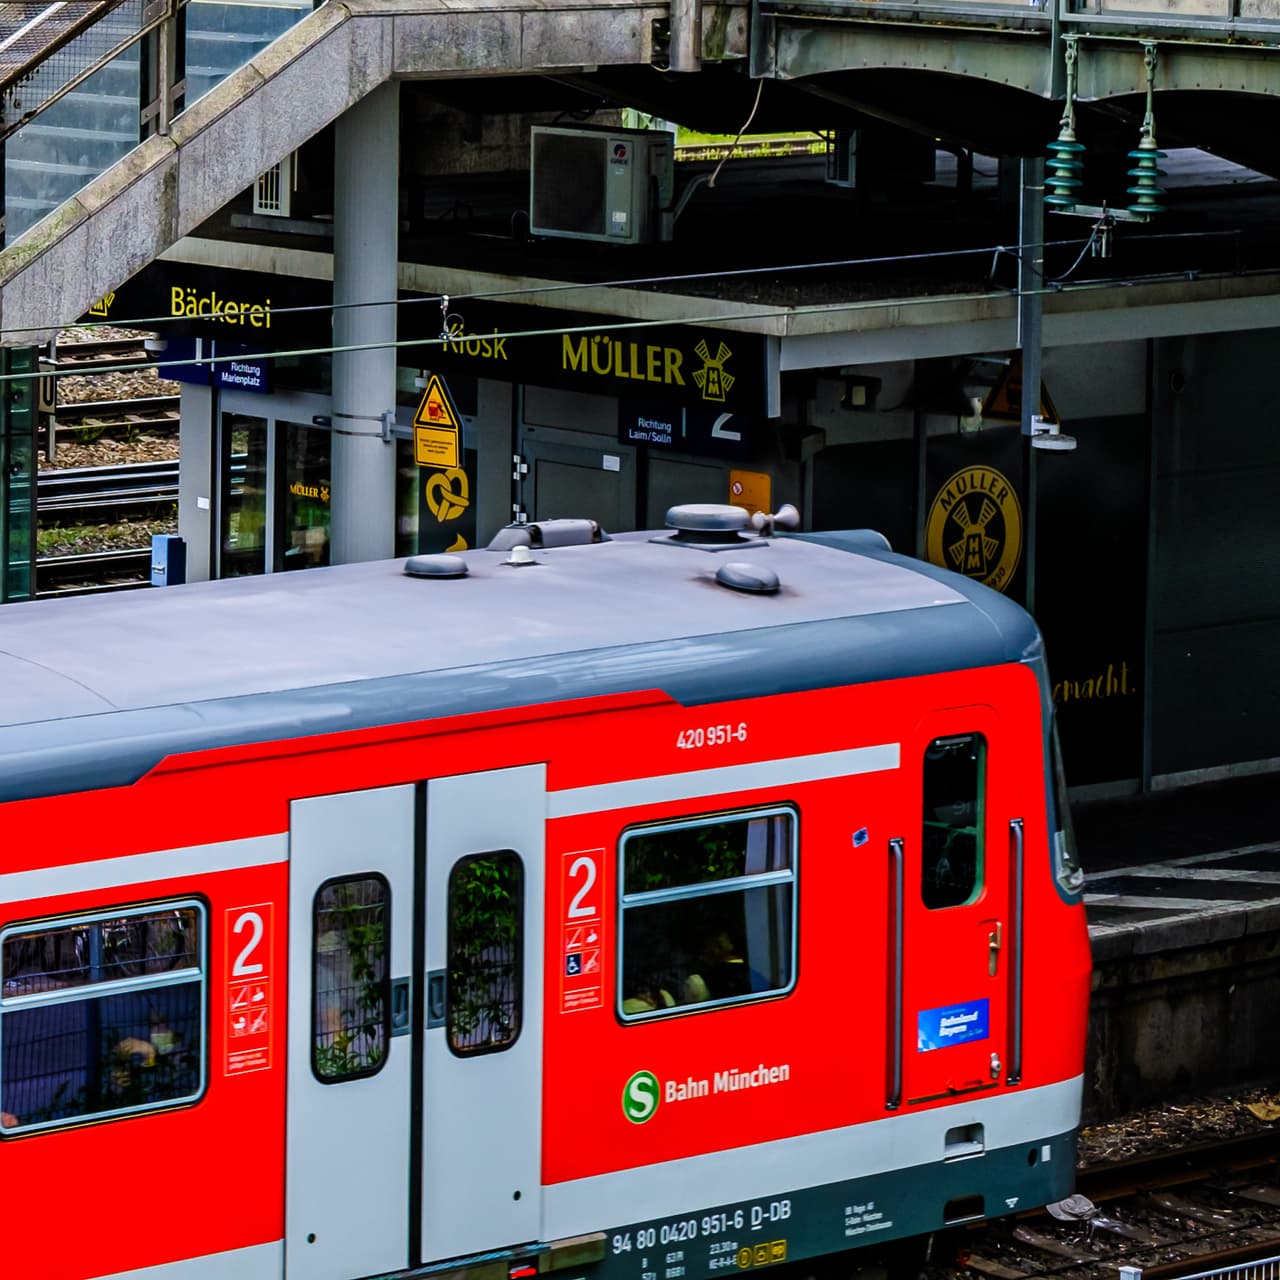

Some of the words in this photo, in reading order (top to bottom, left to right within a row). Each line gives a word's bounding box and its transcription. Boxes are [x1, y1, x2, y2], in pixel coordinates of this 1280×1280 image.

[171, 286, 271, 328] Bäckerei
[442, 323, 508, 361] Kiosk
[561, 334, 686, 387] MÜLLER
[221, 372, 261, 387] Marienplatz
[230, 362, 260, 377] Richtung
[628, 429, 672, 445] Laim/Solln
[637, 417, 672, 434] Richtung
[676, 728, 705, 750] 420
[706, 722, 747, 746] 951-6
[567, 856, 597, 919] 2
[231, 911, 265, 978] 2
[628, 1073, 656, 1121] S
[665, 1077, 708, 1104] Bahn
[713, 1062, 790, 1095] München
[612, 1233, 632, 1255] 94
[636, 1228, 656, 1249] 80
[660, 1219, 697, 1245] 0420
[701, 1210, 744, 1236] 951-6
[750, 1199, 792, 1231] D-DB
